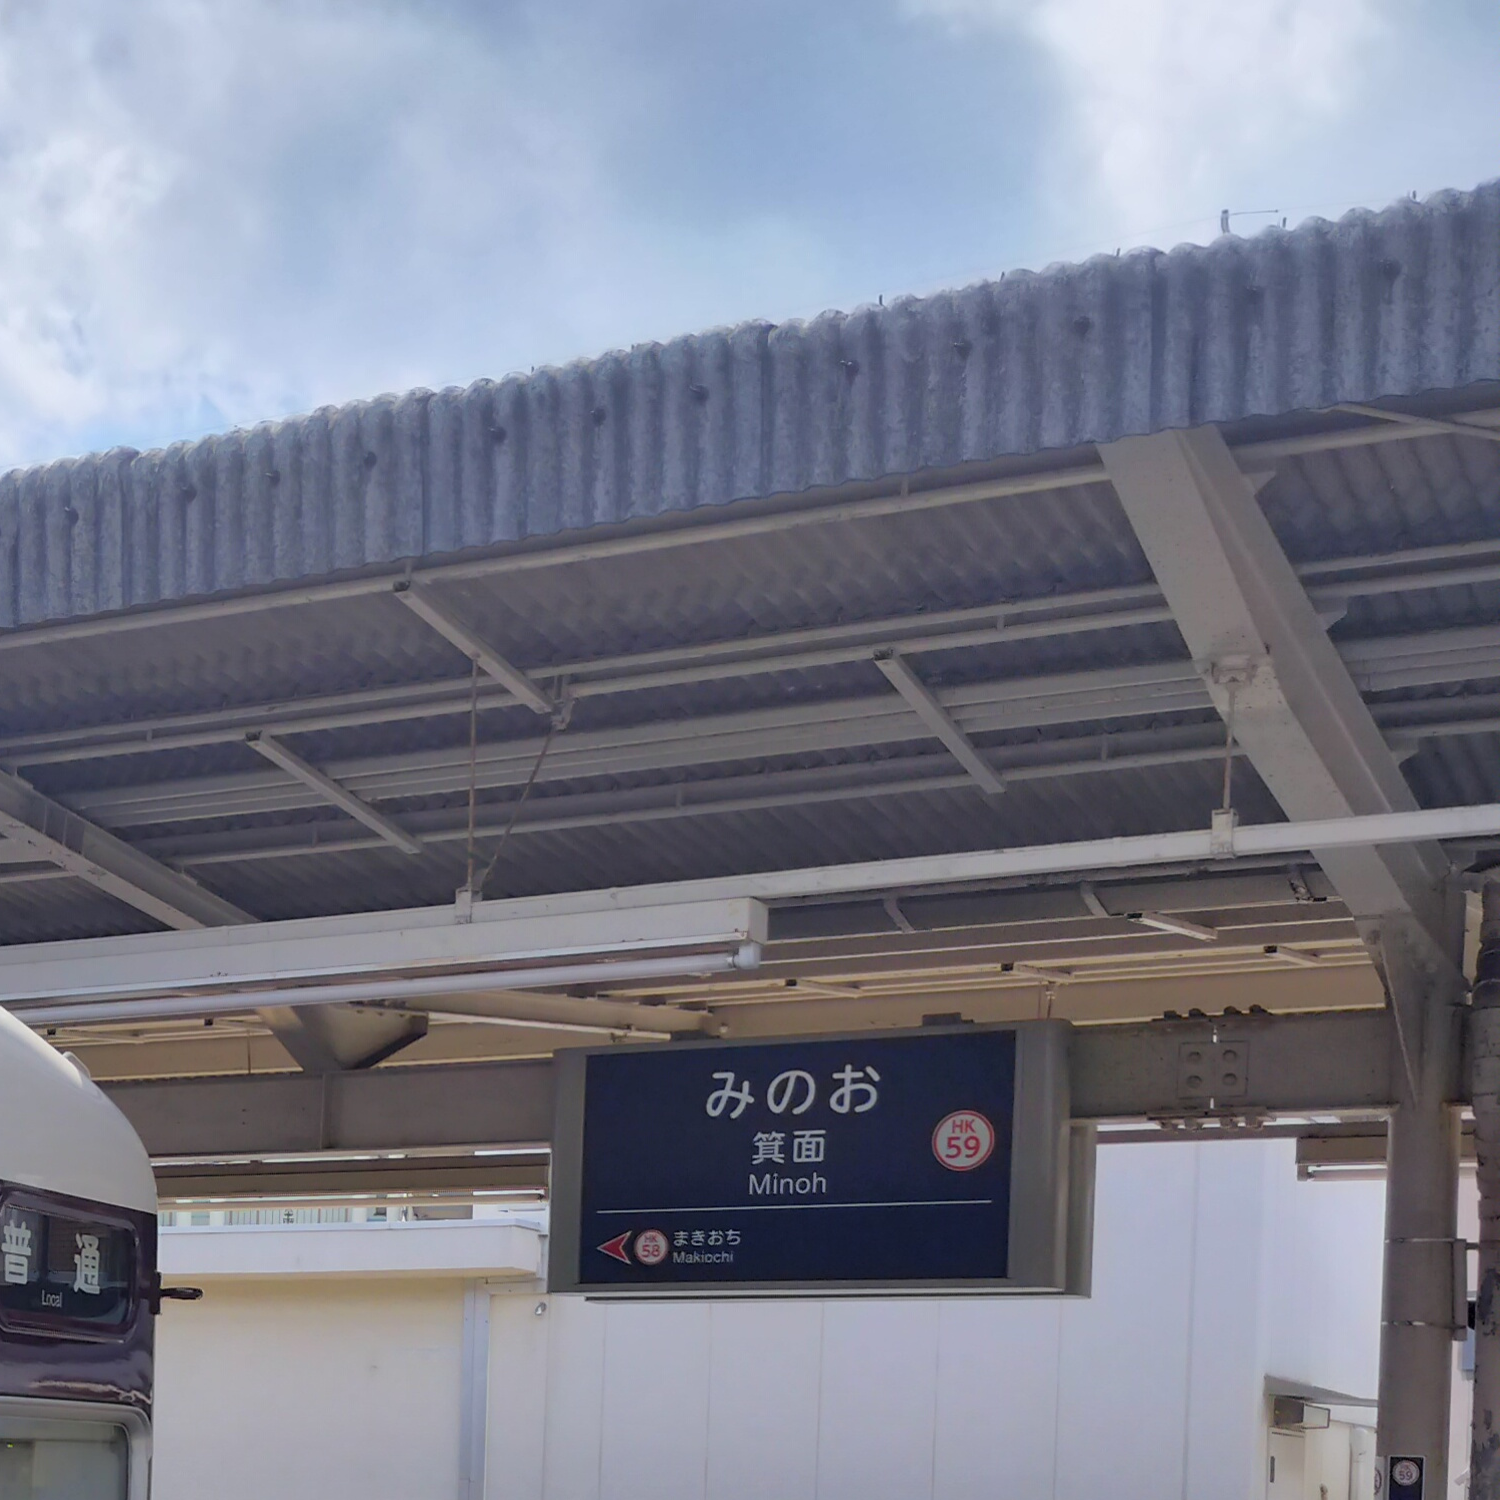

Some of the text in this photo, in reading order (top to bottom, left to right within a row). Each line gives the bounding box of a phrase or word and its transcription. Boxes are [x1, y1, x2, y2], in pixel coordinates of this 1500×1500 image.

[705, 1064, 881, 1119] みのお
[952, 1119, 976, 1134] HK
[751, 1129, 827, 1165] 箕面
[945, 1135, 981, 1159] 59
[748, 1172, 827, 1196] Minoh
[642, 1244, 661, 1258] 58
[672, 1249, 735, 1264] Makiochi
[41, 1289, 63, 1309] Local
[1398, 1470, 1414, 1481] 59
